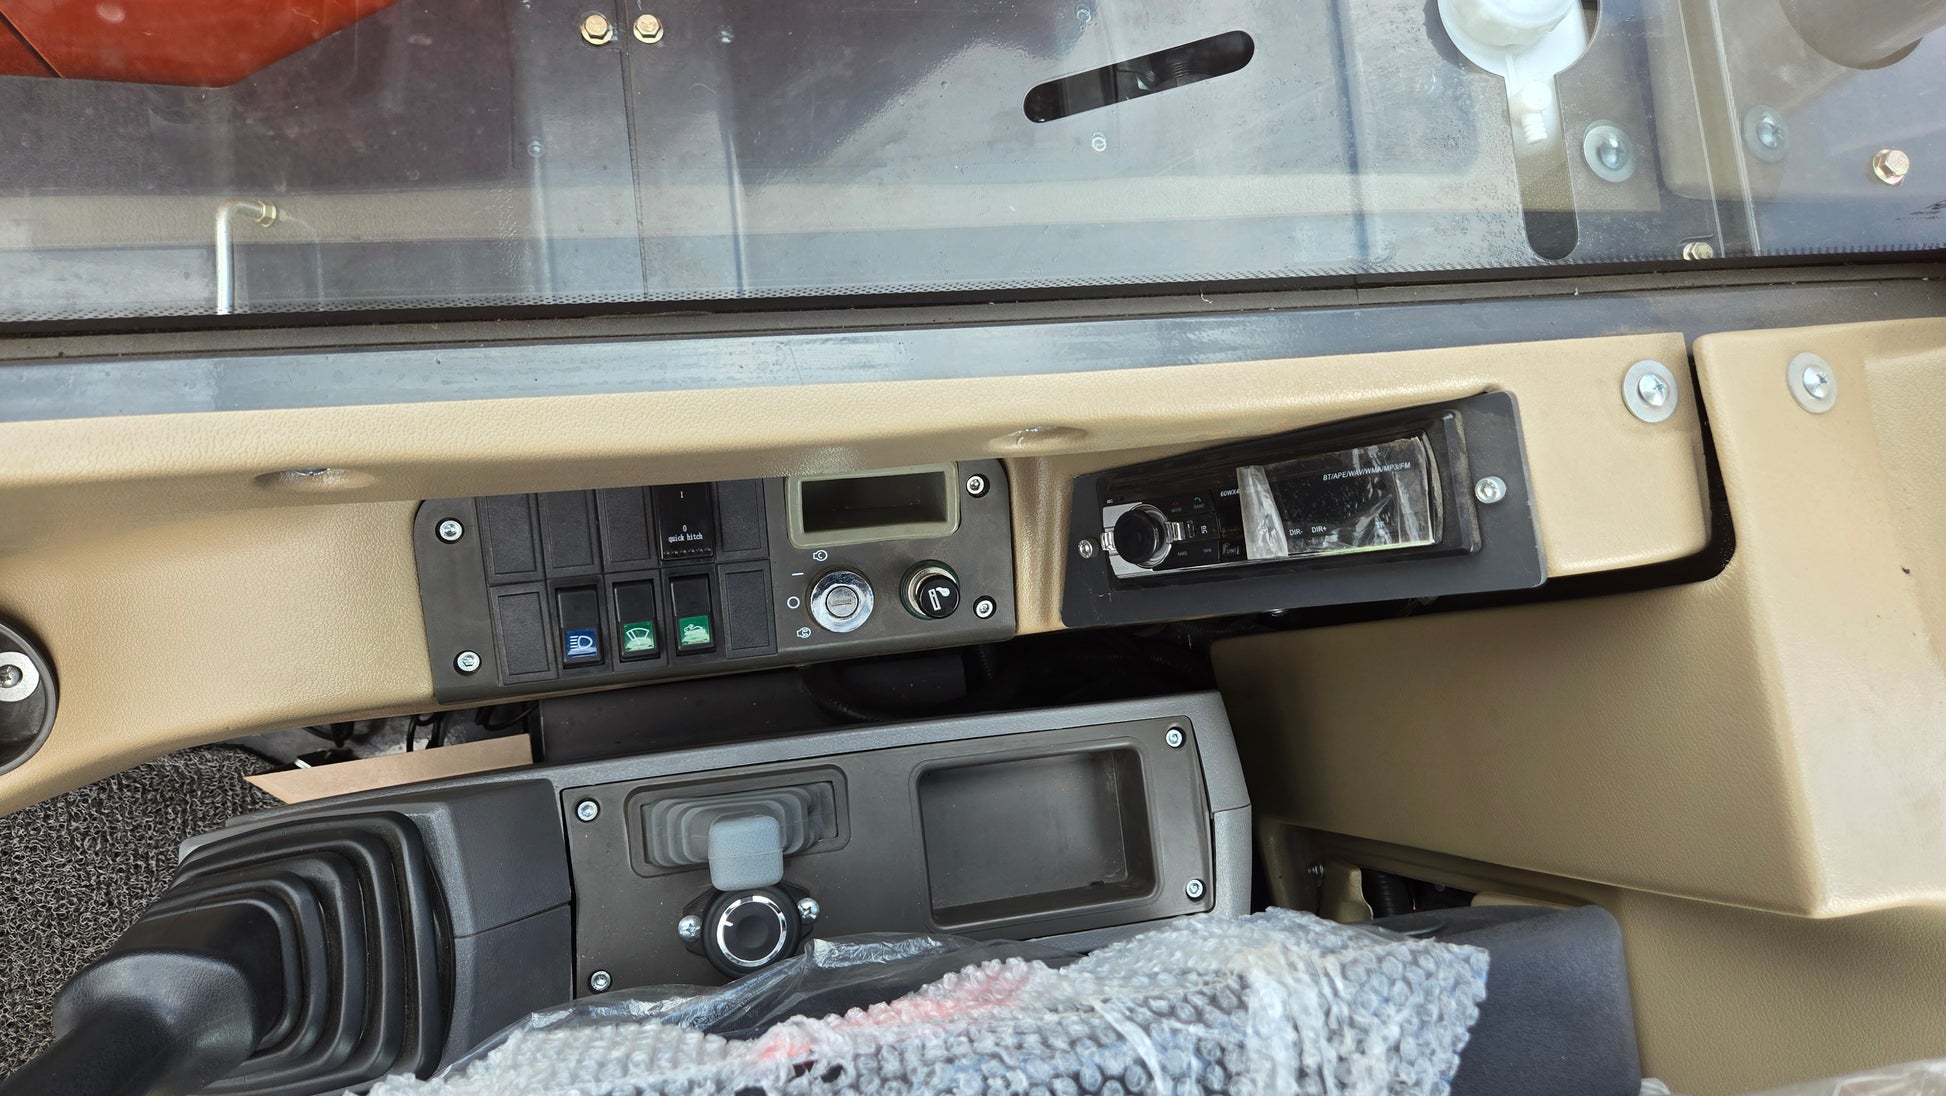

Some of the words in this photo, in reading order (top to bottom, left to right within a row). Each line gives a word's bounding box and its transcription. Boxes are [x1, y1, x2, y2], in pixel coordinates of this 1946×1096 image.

[1322, 461, 1411, 481] BT/APE/WAV/WMA/MP3/FM
[1289, 528, 1303, 536] DIR-
[1311, 525, 1327, 533] DIR+
[668, 534, 685, 544] quick
[686, 532, 704, 541] hitch
